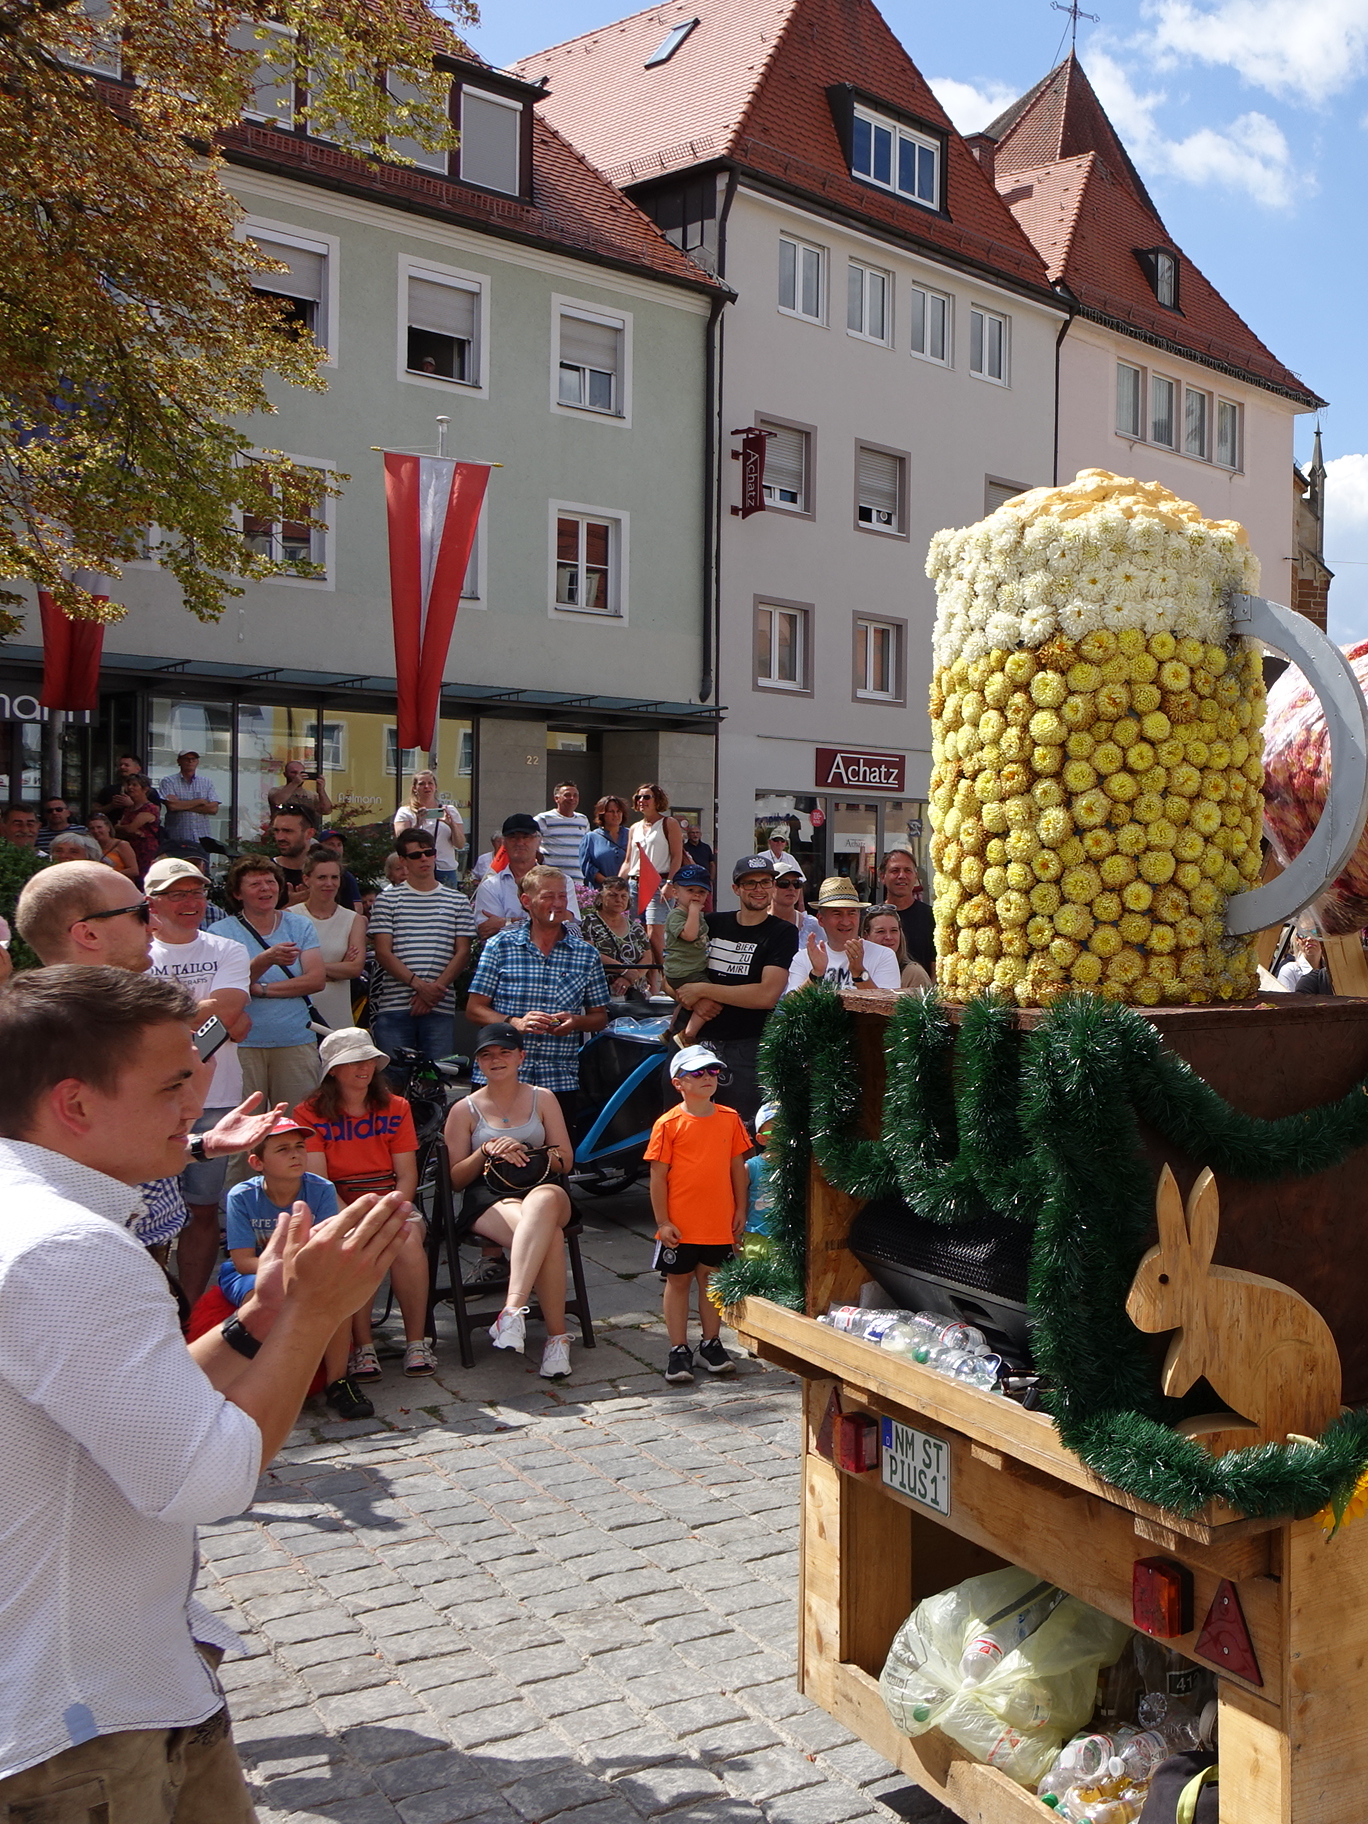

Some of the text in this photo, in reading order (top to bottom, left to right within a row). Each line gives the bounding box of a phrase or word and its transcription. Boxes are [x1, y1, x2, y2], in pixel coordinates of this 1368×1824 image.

[746, 449, 759, 507] Achatz
[526, 755, 539, 765] 22
[827, 753, 899, 784] Achatz
[735, 942, 755, 951] BIER
[739, 953, 751, 962] ZU
[727, 964, 748, 974] MIR!
[314, 1112, 402, 1141] adidas
[895, 1425, 915, 1462] NM
[922, 1439, 943, 1474] ST
